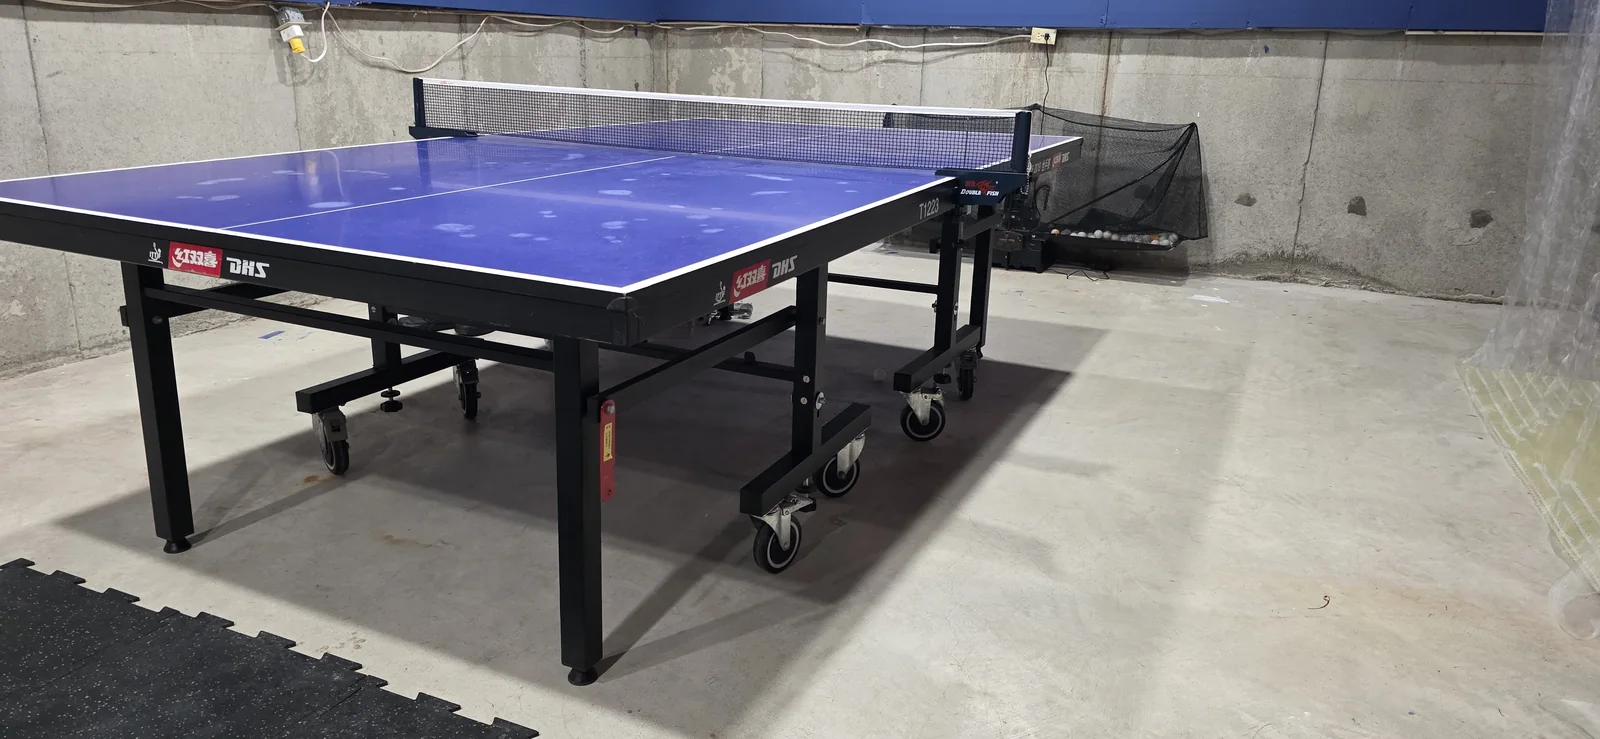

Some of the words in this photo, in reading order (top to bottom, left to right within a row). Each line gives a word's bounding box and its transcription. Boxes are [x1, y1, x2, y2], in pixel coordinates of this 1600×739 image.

[919, 198, 939, 219] T1223
[172, 248, 218, 268] 红双喜
[226, 257, 270, 278] DHS
[772, 255, 798, 278] DHS
[733, 264, 766, 298] 红双喜
